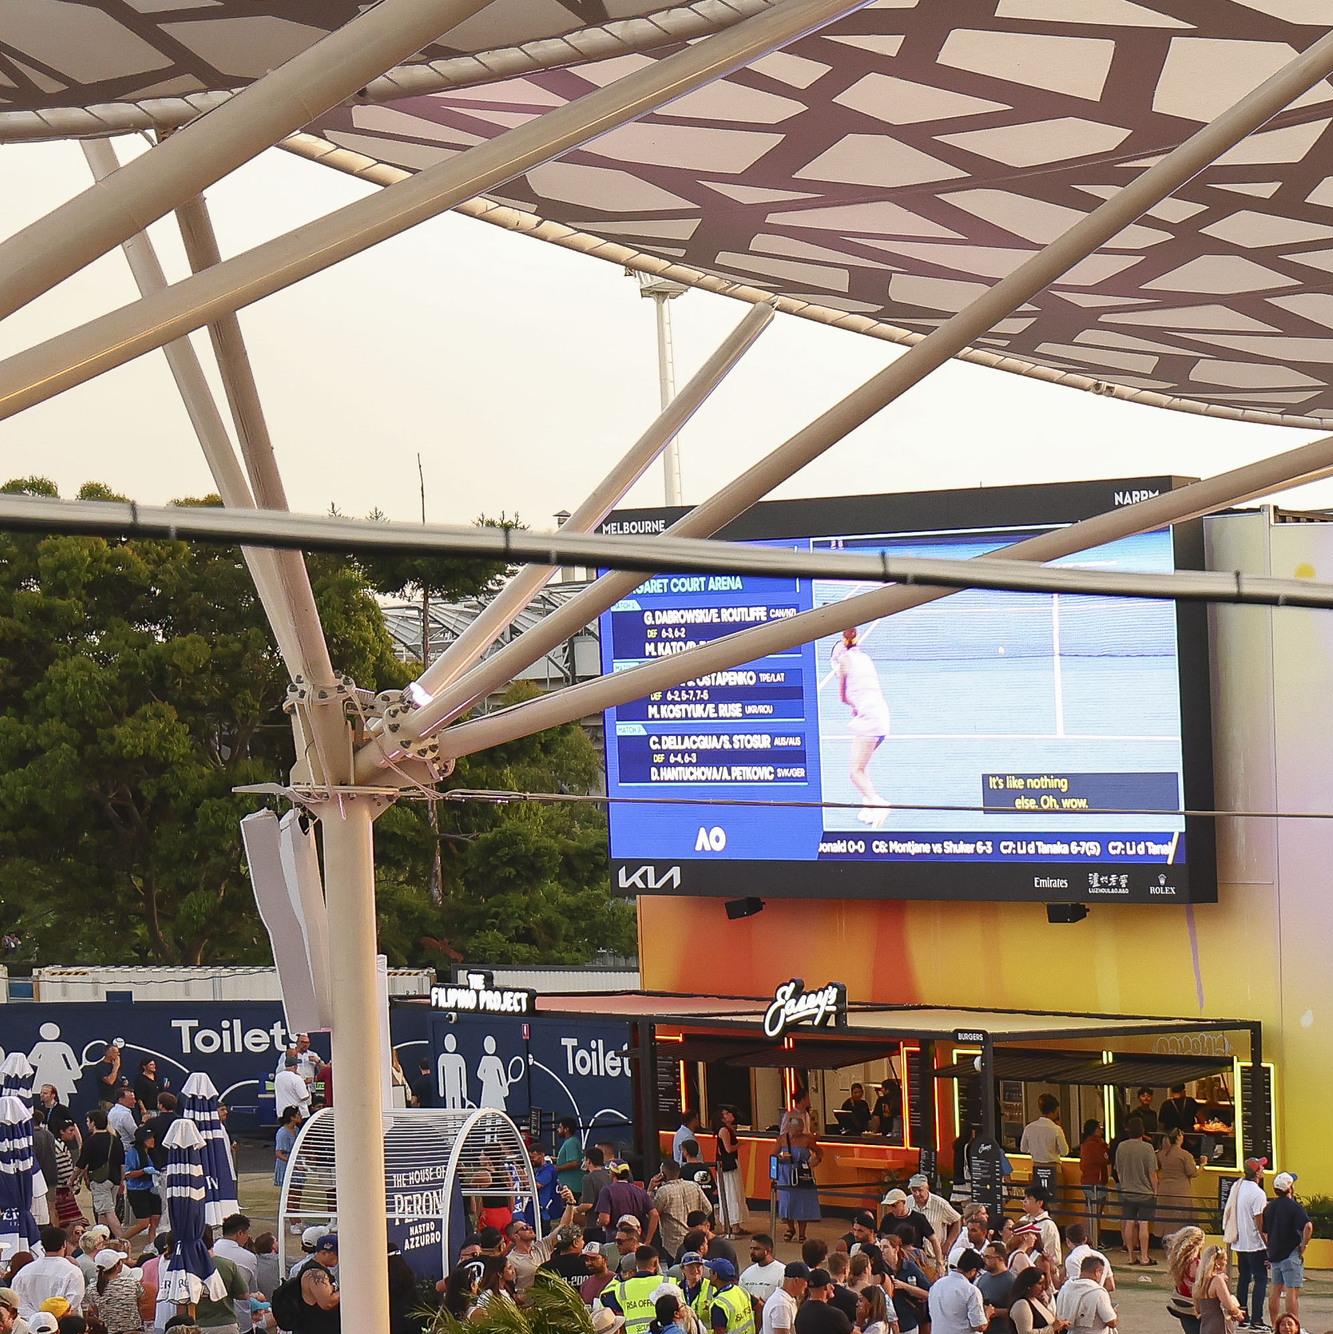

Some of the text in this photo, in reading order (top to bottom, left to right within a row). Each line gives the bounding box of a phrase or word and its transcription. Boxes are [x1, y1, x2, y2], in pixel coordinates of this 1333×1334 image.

[602, 520, 666, 535] MELBOURNE
[670, 576, 743, 593] COURT ARENA
[718, 704, 743, 718] RUSE
[733, 734, 771, 749] STOSUR
[653, 754, 665, 763] DEF
[732, 766, 775, 780] PETKOVIC
[988, 775, 1069, 792] It's like nothing
[1015, 795, 1039, 809] else.
[1061, 797, 1089, 809] wow.
[695, 826, 727, 851] AO
[932, 843, 943, 854] vs
[618, 865, 681, 889] KIA
[1034, 877, 1069, 889] Emirates
[1150, 886, 1176, 895] ROLEX
[431, 987, 529, 1013] FILIPINO PROJECT
[171, 1019, 297, 1053] Toilet
[957, 1032, 984, 1042] BURGERS
[393, 1165, 446, 1188] THE HOUSE OF
[394, 1189, 444, 1225] PERON
[410, 1221, 435, 1237] NASTRO
[404, 1231, 441, 1251] AZZURRO
